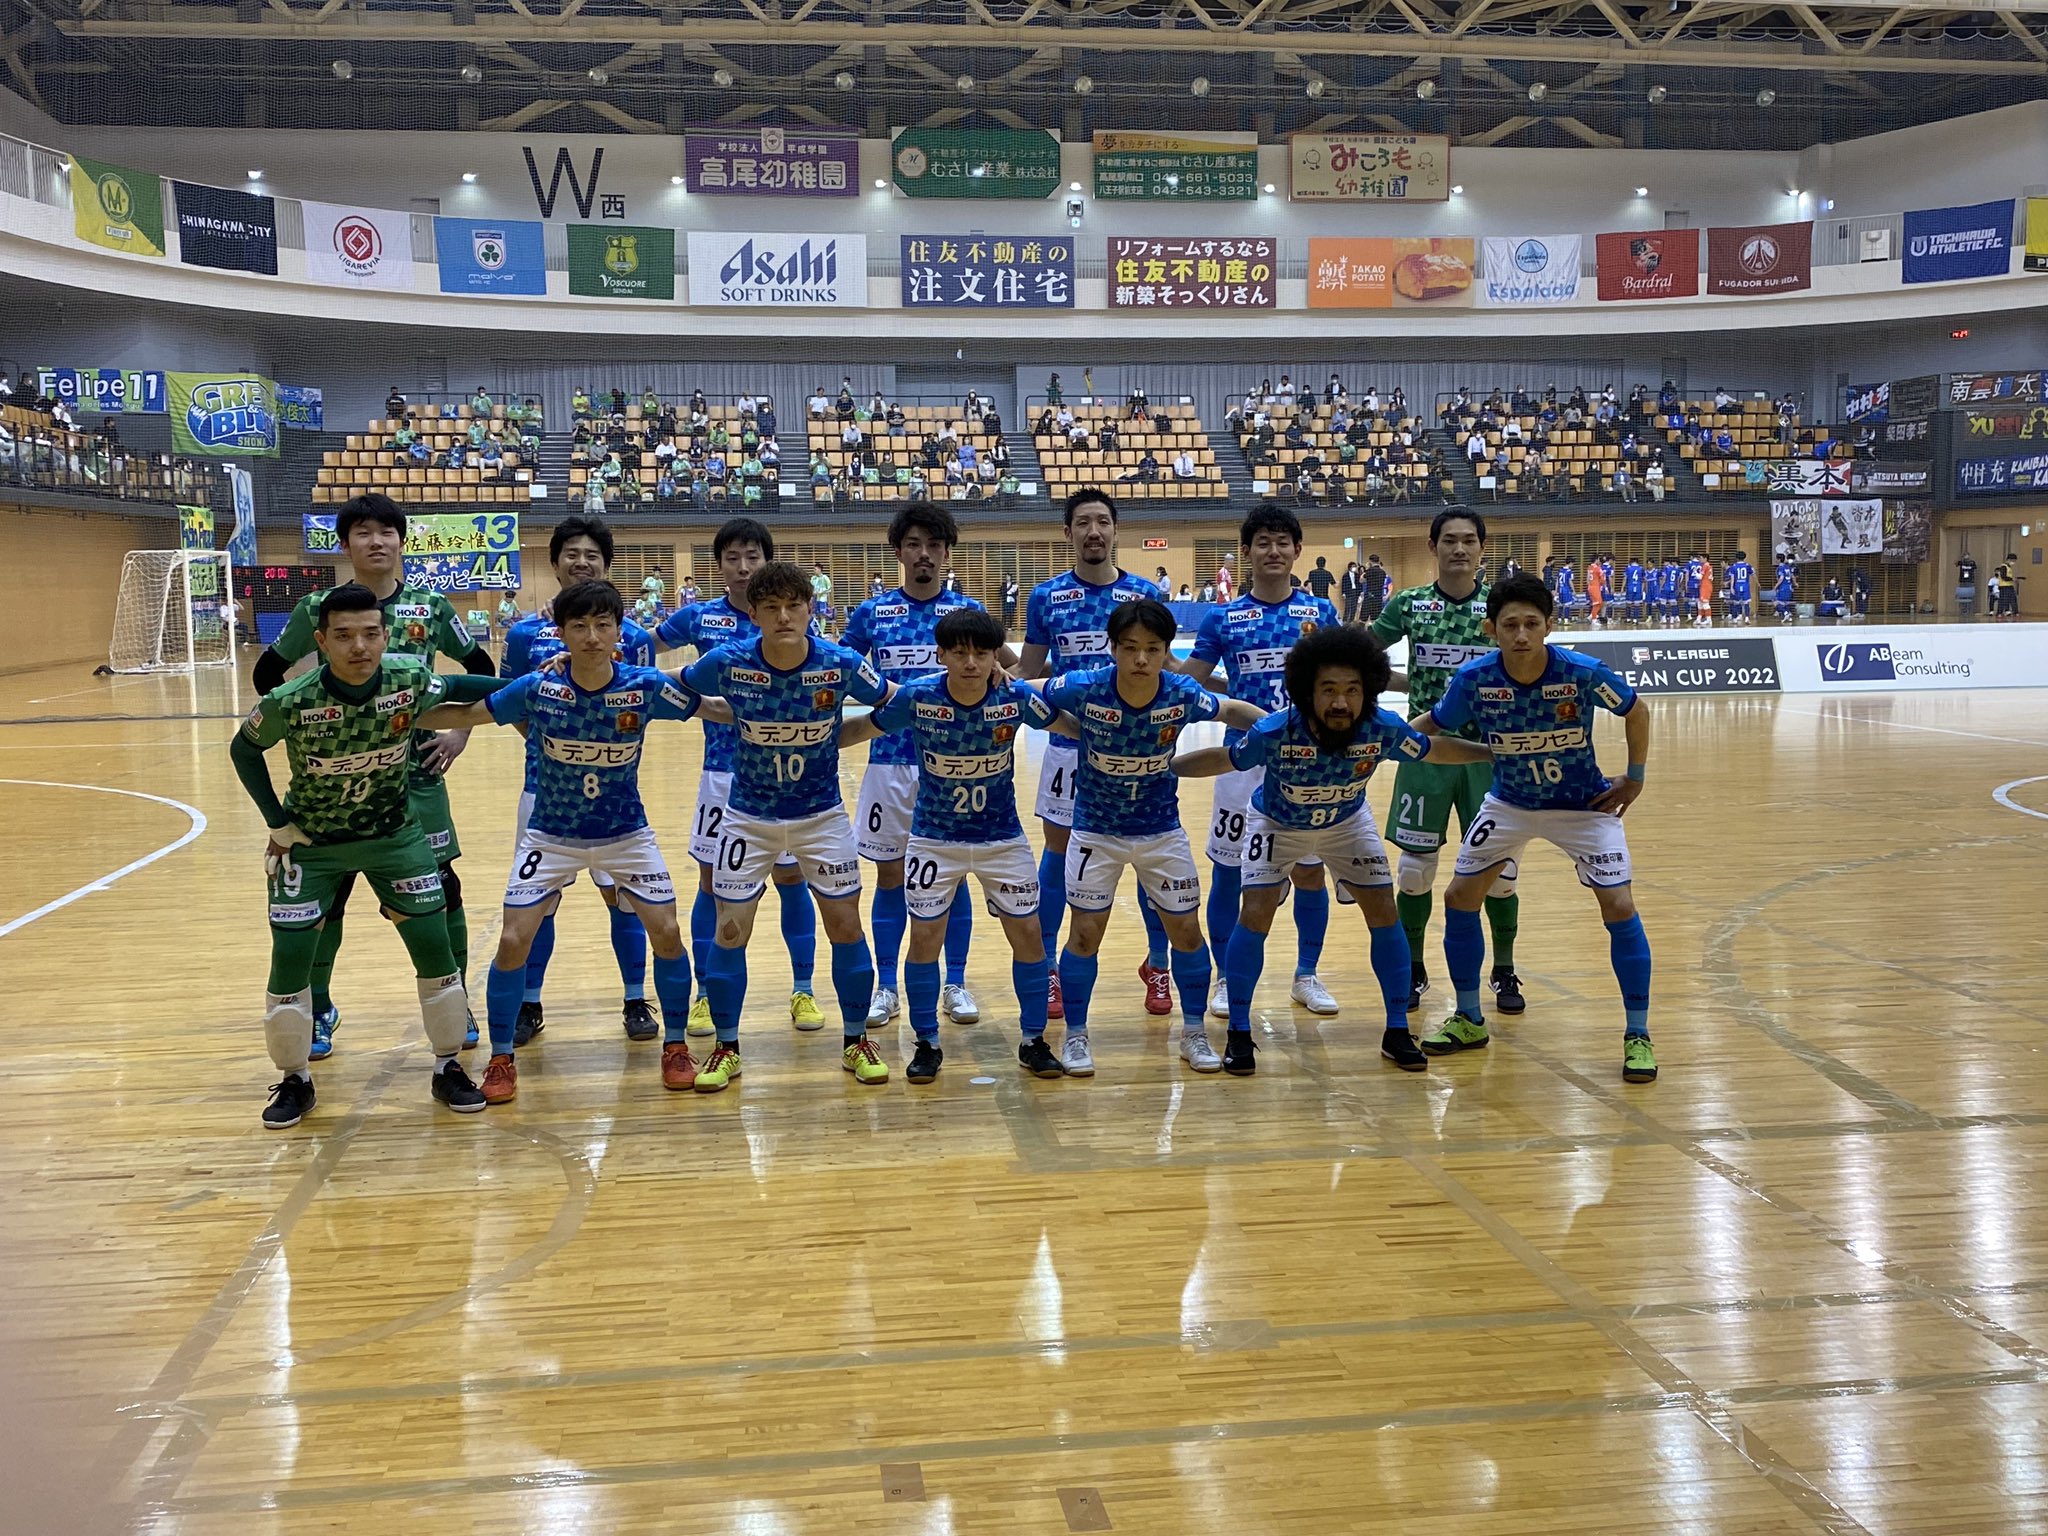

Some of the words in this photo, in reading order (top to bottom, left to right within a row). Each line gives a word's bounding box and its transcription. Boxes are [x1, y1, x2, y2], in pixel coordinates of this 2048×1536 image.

[718, 142, 758, 153] 学校法人
[700, 157, 847, 190] 高尾幼稚園
[1015, 166, 1058, 179] 株式会社
[522, 146, 604, 219] W
[1152, 186, 1251, 195] 042-643-3321
[600, 194, 625, 219] 西
[908, 240, 1068, 264] 住友不動産の
[1117, 240, 1270, 257] リフォームするなら
[1929, 239, 1984, 255] ATHLETIC
[338, 254, 381, 271] LIGAREVIA
[720, 238, 837, 285] Asahi
[1351, 264, 1386, 273] TAKAO
[1115, 258, 1270, 284] 住友不動産の
[1351, 273, 1386, 282] POTATO
[908, 267, 1068, 302] 注文住宅
[1316, 277, 1348, 291] ポテト
[1622, 273, 1673, 289] Bardral
[721, 287, 766, 302] SOFT
[771, 288, 837, 302] DRINKS
[1116, 285, 1269, 305] 新築そっくりさん
[1489, 282, 1575, 299] Espolada
[38, 372, 126, 400] Felipe
[129, 374, 158, 400] 11
[1771, 463, 1846, 492] 黒本
[471, 515, 517, 550] 13
[470, 554, 511, 590] 44
[1052, 590, 1084, 603] HOKTO
[396, 606, 429, 617] HOKTO
[876, 606, 908, 617] HOKTO
[1290, 607, 1318, 617] HOKTO
[1413, 602, 1443, 612] HOKTO
[703, 618, 735, 629] HOKTO
[1229, 610, 1262, 622] HOKTO
[1075, 635, 1108, 652] デン
[1653, 649, 1730, 660] F.LEAGUE
[1868, 647, 1924, 662] ABeam
[732, 670, 769, 684] HOKTO
[804, 672, 840, 684] HOKTO
[1615, 670, 1669, 688] EAN
[1676, 669, 1717, 686] CUP
[1726, 667, 1775, 685] 2022
[1895, 661, 1971, 678] Consulting
[540, 685, 575, 702] HOKTO
[607, 693, 642, 706] HOKTO
[733, 690, 763, 699] ATHLETA
[1269, 679, 1290, 711] 3
[1481, 690, 1513, 701] HOKTO
[1544, 686, 1577, 698] HOKTO
[377, 692, 413, 711] HOKTO
[303, 707, 342, 723] HOKTO
[538, 706, 568, 717] ATHLETA
[918, 707, 953, 720] HOKTO
[985, 705, 1018, 720] HOKTO
[1087, 707, 1120, 723] HOKTO
[1152, 707, 1184, 724] HOKTO
[758, 722, 833, 744] デンセン
[1511, 729, 1585, 752] デンセン
[562, 743, 636, 763] デンセン
[1282, 748, 1316, 759] HOKTO
[773, 753, 805, 783] 10
[943, 754, 1010, 776] デンセン
[1528, 758, 1563, 785] 16
[338, 777, 371, 805] 19
[583, 773, 600, 799] 8
[1051, 767, 1076, 801] 41
[1123, 782, 1140, 801] 7
[953, 785, 987, 814] 20
[868, 802, 883, 833] 6
[1310, 808, 1341, 827] 81
[1399, 793, 1424, 827] 21
[698, 803, 723, 838] 12
[1214, 808, 1244, 842] 39
[1463, 816, 1496, 847] 16
[717, 836, 747, 872] 10
[1248, 833, 1275, 862] 81
[519, 850, 543, 880] 8
[906, 856, 938, 890] 20
[1078, 847, 1093, 882] 7
[415, 895, 441, 904] ATHLETA
